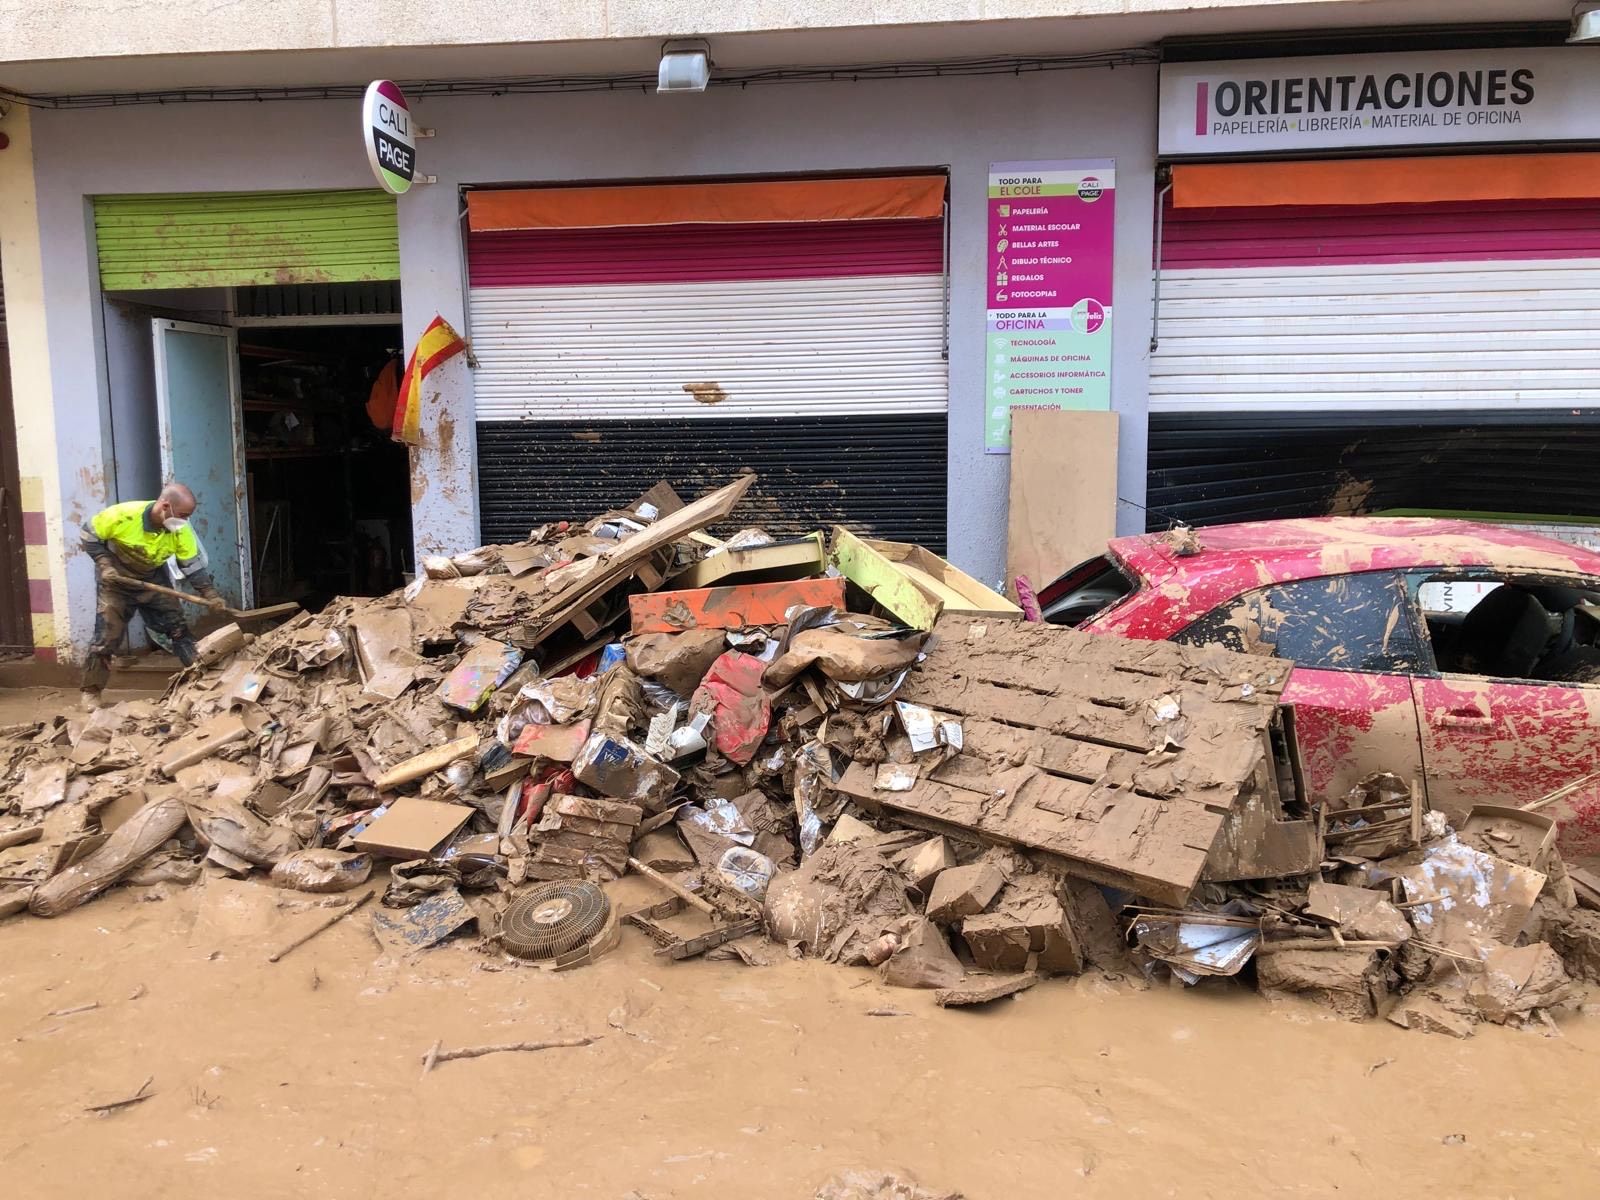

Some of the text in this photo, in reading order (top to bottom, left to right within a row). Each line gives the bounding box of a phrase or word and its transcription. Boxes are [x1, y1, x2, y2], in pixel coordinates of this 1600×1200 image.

[1215, 69, 1535, 116] ORIENTACIONES
[379, 103, 408, 137] CALI
[1213, 110, 1522, 136] PAPELERÍA LIBRERÍA MATERIAL DE OFICINA
[379, 138, 411, 173] PAGE
[998, 176, 1043, 185] TODO PARA
[1000, 185, 1041, 196] EL COLE
[1012, 207, 1048, 215] PAPELERÍA
[1012, 223, 1081, 232] MATERIAL ESCOLAR
[1037, 240, 1059, 248] ARTES
[1040, 256, 1072, 264] TÉCNICO
[1011, 274, 1044, 282] REGALOS
[1011, 290, 1057, 298] FOTOCOPIAS
[996, 319, 1045, 330] OFICINA
[1010, 355, 1049, 363] MÁQUINAS
